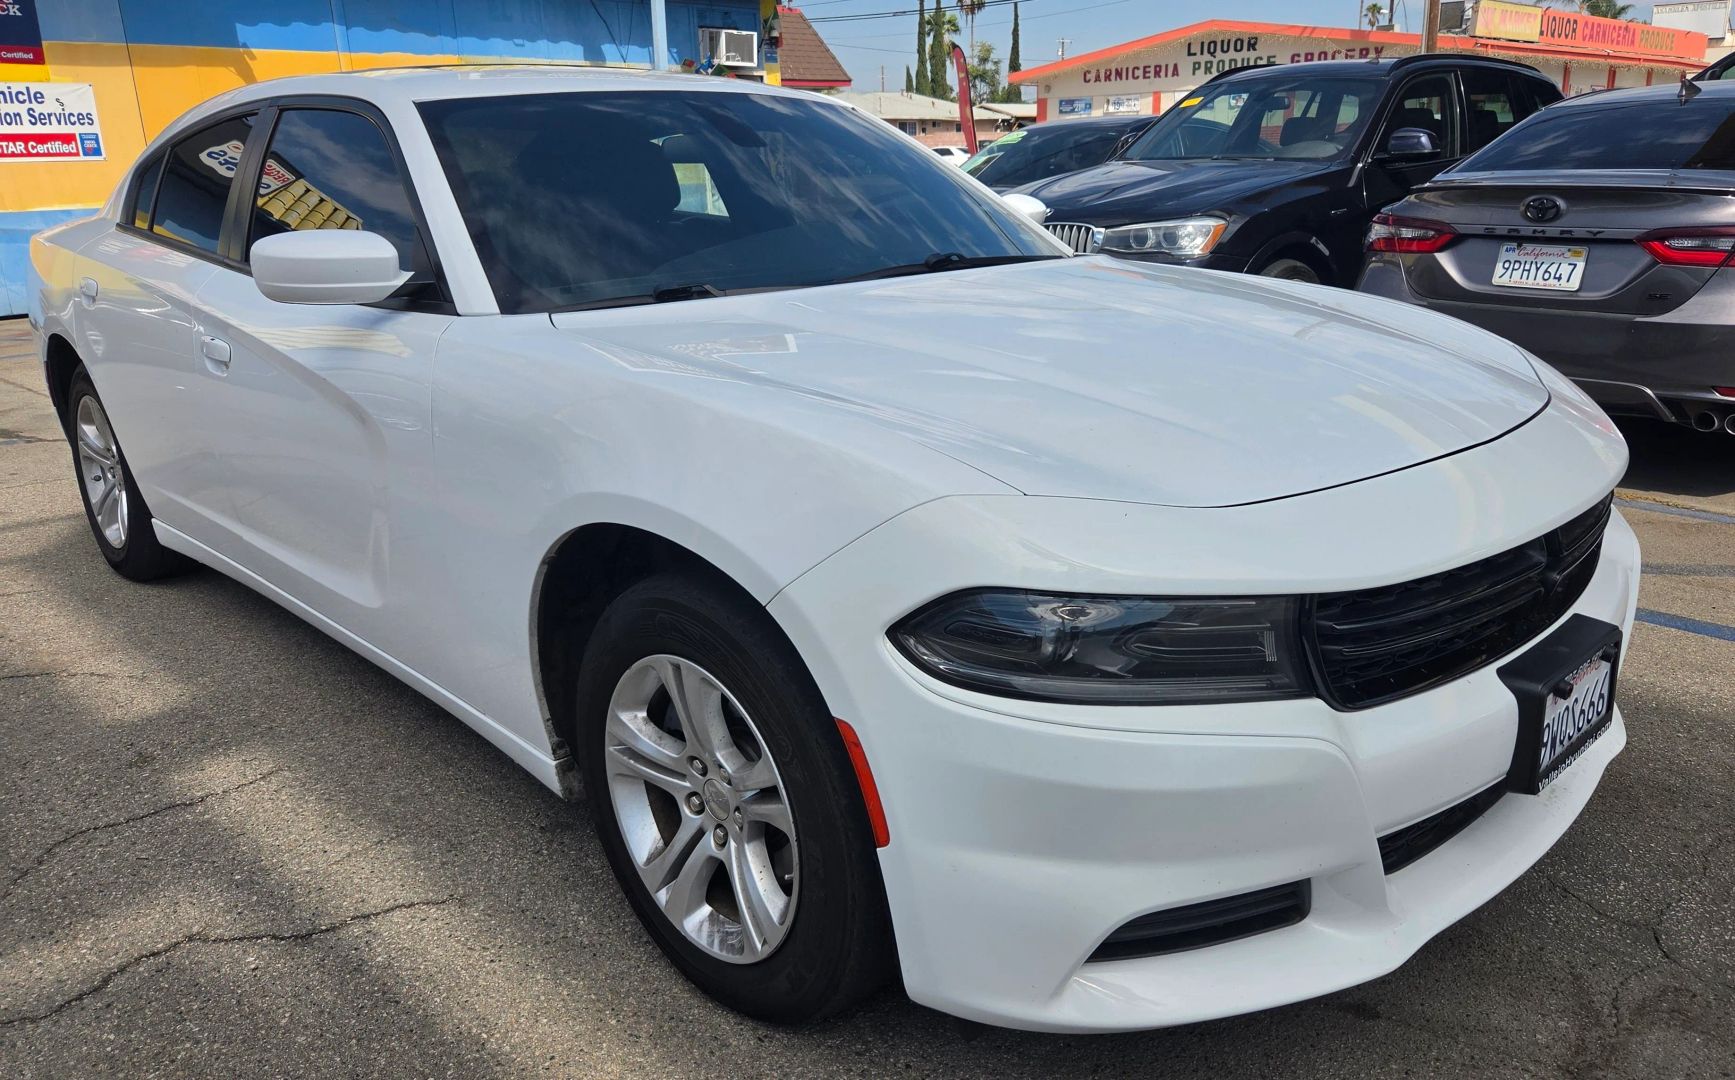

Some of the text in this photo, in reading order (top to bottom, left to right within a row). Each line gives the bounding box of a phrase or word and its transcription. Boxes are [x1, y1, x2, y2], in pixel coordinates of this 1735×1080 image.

[1540, 15, 1676, 51] LIQUOR CARNICERIA PRODUCE
[1, 51, 33, 60] Certified
[1187, 37, 1259, 59] LIQUOR
[1083, 63, 1180, 84] CARNICERIA
[27, 107, 94, 126] Services
[0, 141, 27, 154] TAR
[28, 141, 77, 154] Certified
[1483, 227, 1605, 237] CAMRY
[1504, 246, 1516, 254] APR
[1517, 246, 1570, 260] California
[1499, 260, 1577, 283] 9PHY647
[1540, 670, 1608, 765] 9WQS666
